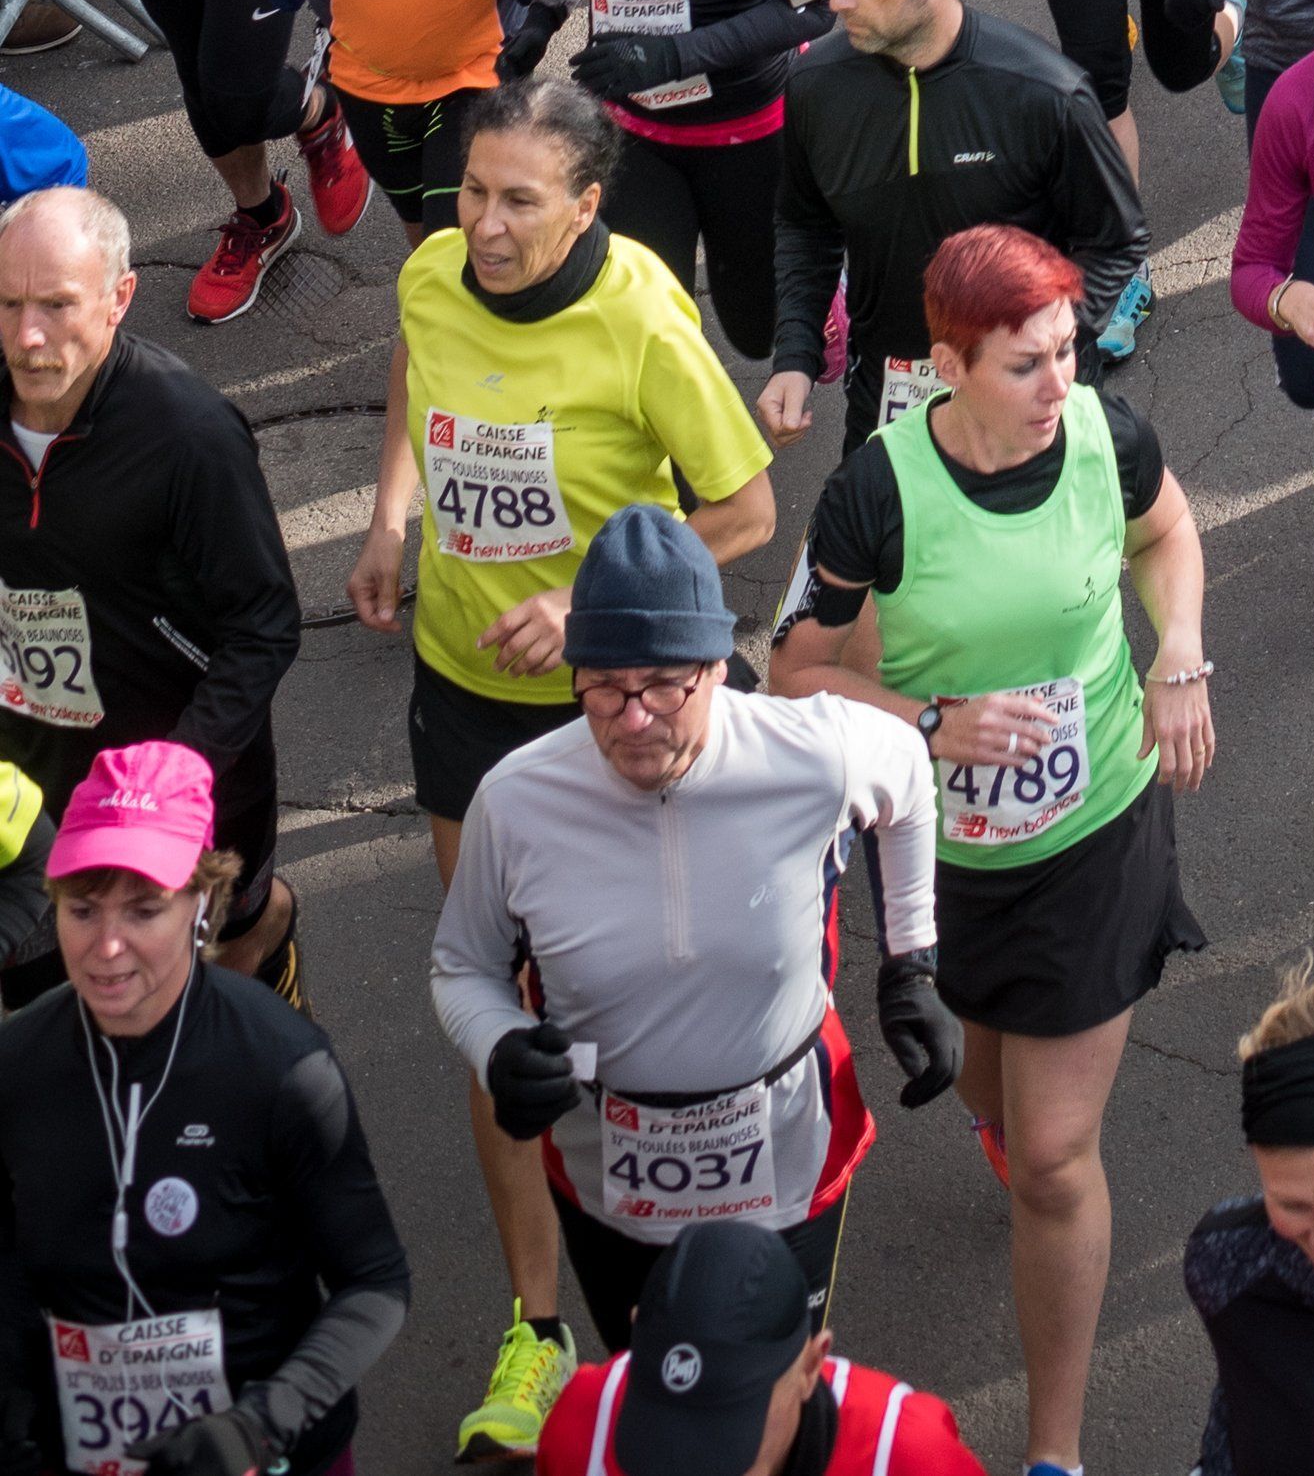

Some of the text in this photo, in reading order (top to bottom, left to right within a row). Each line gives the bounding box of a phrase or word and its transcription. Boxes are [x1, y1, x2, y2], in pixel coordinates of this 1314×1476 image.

[611, 2, 684, 16] D'EPARGNE
[476, 424, 527, 442] CAISSE
[460, 439, 548, 461] D'EPARGNE
[436, 478, 556, 529] 4788
[473, 535, 572, 558] new balance
[12, 646, 85, 695] 192
[671, 1091, 740, 1122] CAISSE
[608, 1140, 764, 1193] 4037
[656, 1193, 773, 1219] new balance
[117, 1319, 188, 1344] CAISSE
